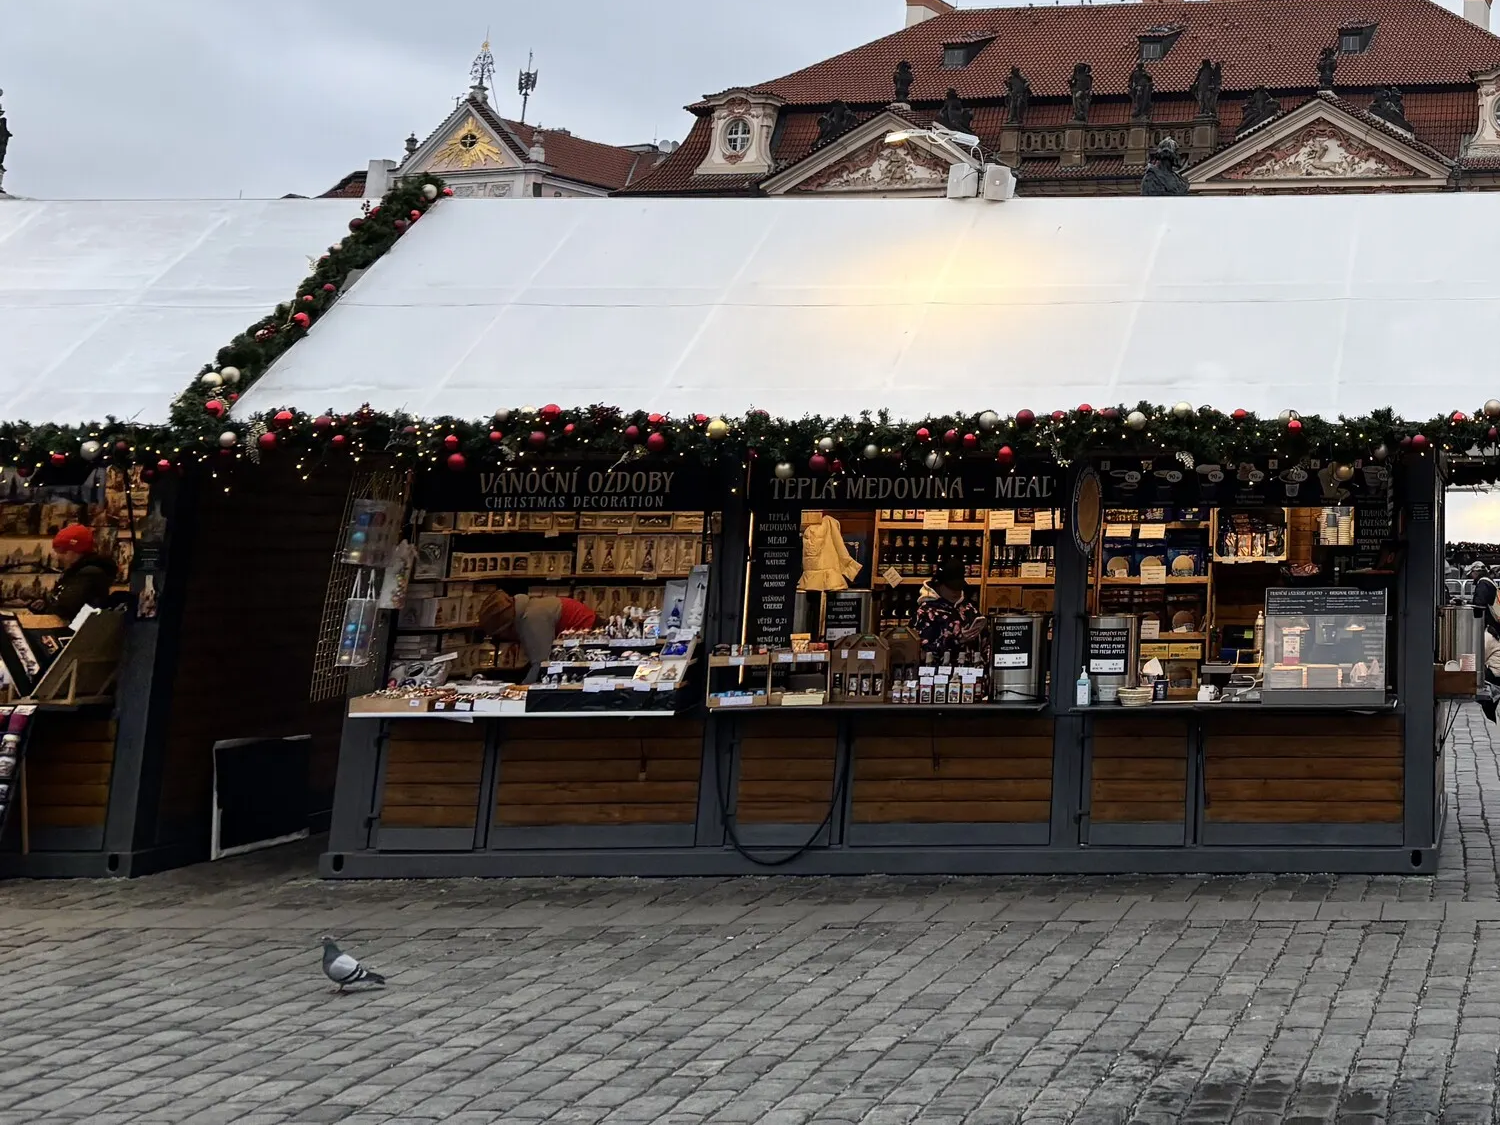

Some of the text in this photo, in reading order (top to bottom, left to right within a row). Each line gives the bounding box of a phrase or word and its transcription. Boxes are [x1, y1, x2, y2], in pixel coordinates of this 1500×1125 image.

[769, 473, 837, 500] TEPLÁ
[846, 477, 964, 499] MEDOVINA
[994, 476, 1056, 499] MEAD
[485, 496, 664, 508] CHRISTMAS DECORATION
[759, 523, 797, 532] MEDOVINA
[767, 536, 788, 545] MEAD
